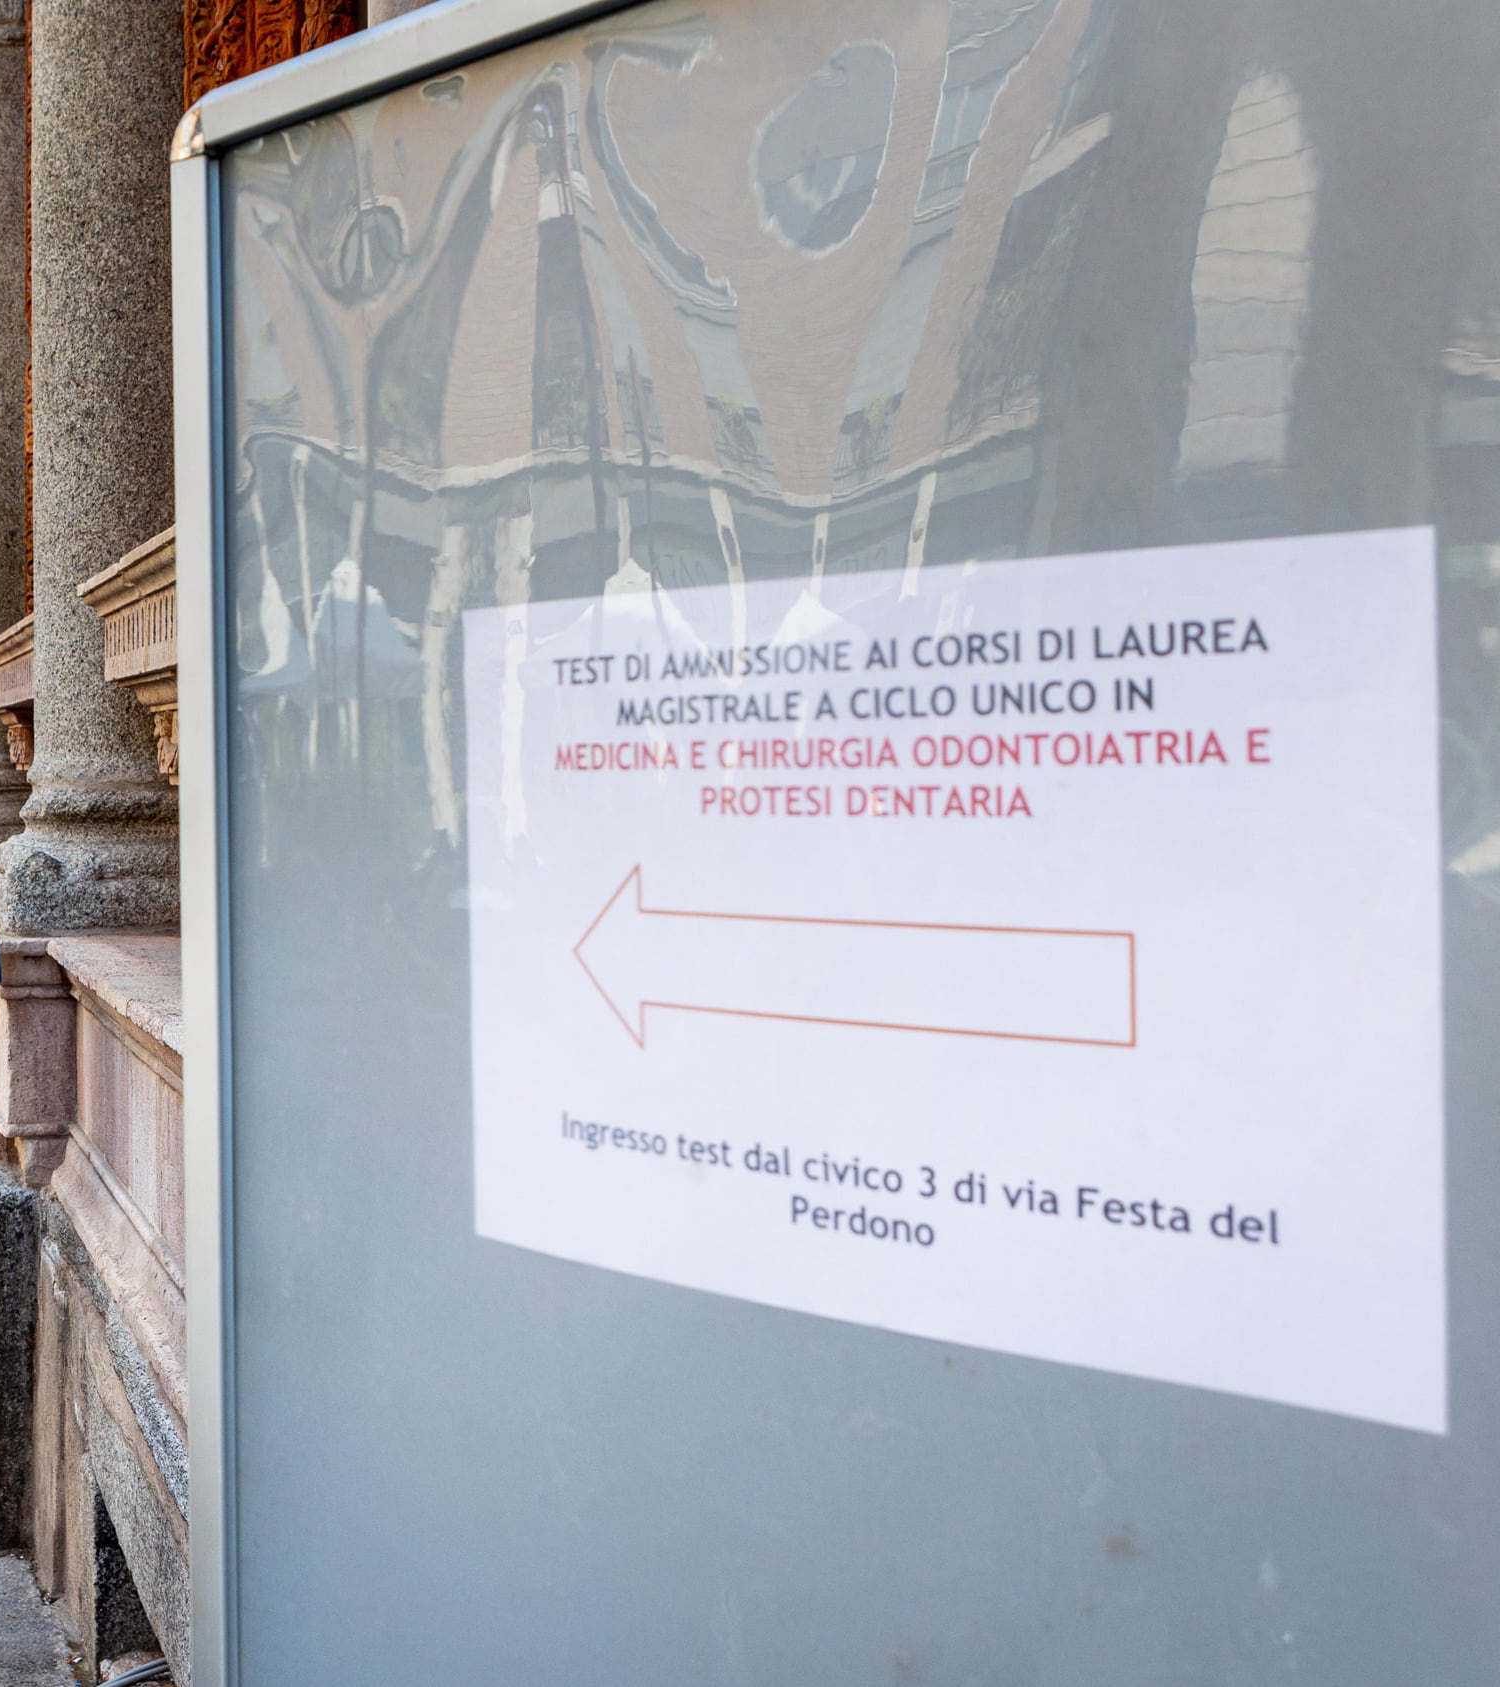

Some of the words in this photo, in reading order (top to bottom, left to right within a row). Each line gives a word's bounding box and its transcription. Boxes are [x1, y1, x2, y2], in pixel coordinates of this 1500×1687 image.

[553, 655, 615, 685] TEST
[625, 654, 651, 681] DI
[865, 638, 898, 669] AI
[912, 631, 1021, 667] CORSI
[1038, 628, 1075, 661] DI
[1093, 618, 1269, 659] LAUREA
[616, 692, 802, 726] MAGISTRALE
[814, 690, 837, 720] A
[850, 686, 957, 719] CICLO
[972, 680, 1097, 716] UNICO
[1114, 678, 1154, 712] IN
[555, 742, 679, 771] MEDICINA
[690, 741, 706, 770] E
[717, 737, 899, 769] CHIRURGIA
[912, 730, 1228, 767] ODONTOIATRIA
[1246, 729, 1271, 763] E
[701, 786, 831, 815] PROTESI
[846, 786, 1033, 817] DENTARIA
[561, 1111, 667, 1156] Ingresso
[678, 1134, 731, 1168] test
[743, 1144, 791, 1176] dal
[803, 1154, 903, 1193] civico
[918, 1166, 937, 1197] 3
[954, 1172, 986, 1204] di
[1003, 1180, 1059, 1215] via
[1076, 1186, 1191, 1233] Festa
[1209, 1204, 1279, 1244] del
[791, 1195, 935, 1247] Perdono
